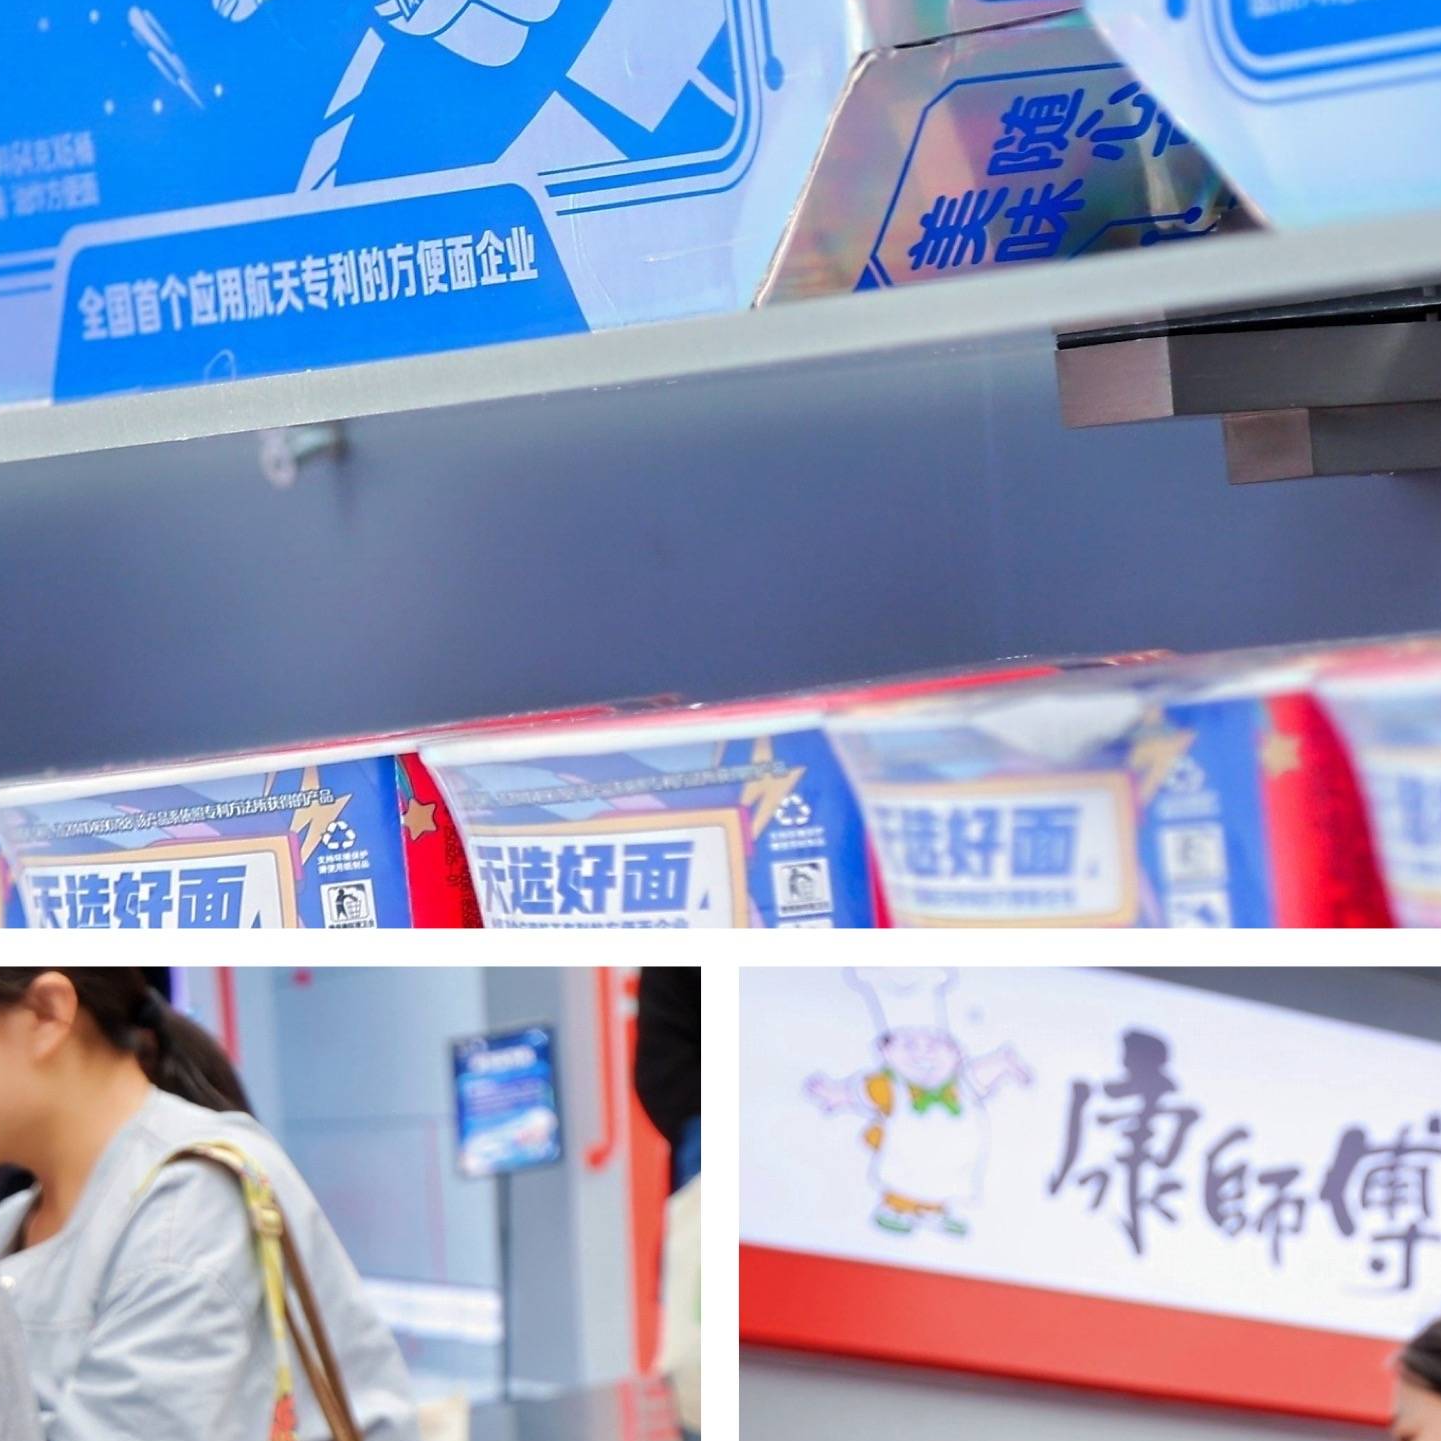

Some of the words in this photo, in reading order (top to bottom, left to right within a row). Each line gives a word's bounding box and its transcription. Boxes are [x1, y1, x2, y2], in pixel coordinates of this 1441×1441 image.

[908, 178, 1084, 270] 美味
[78, 224, 538, 342] 全国首个应用航天专利的方便面企业
[32, 866, 247, 928] 天选好面
[476, 841, 694, 915] 天选好面
